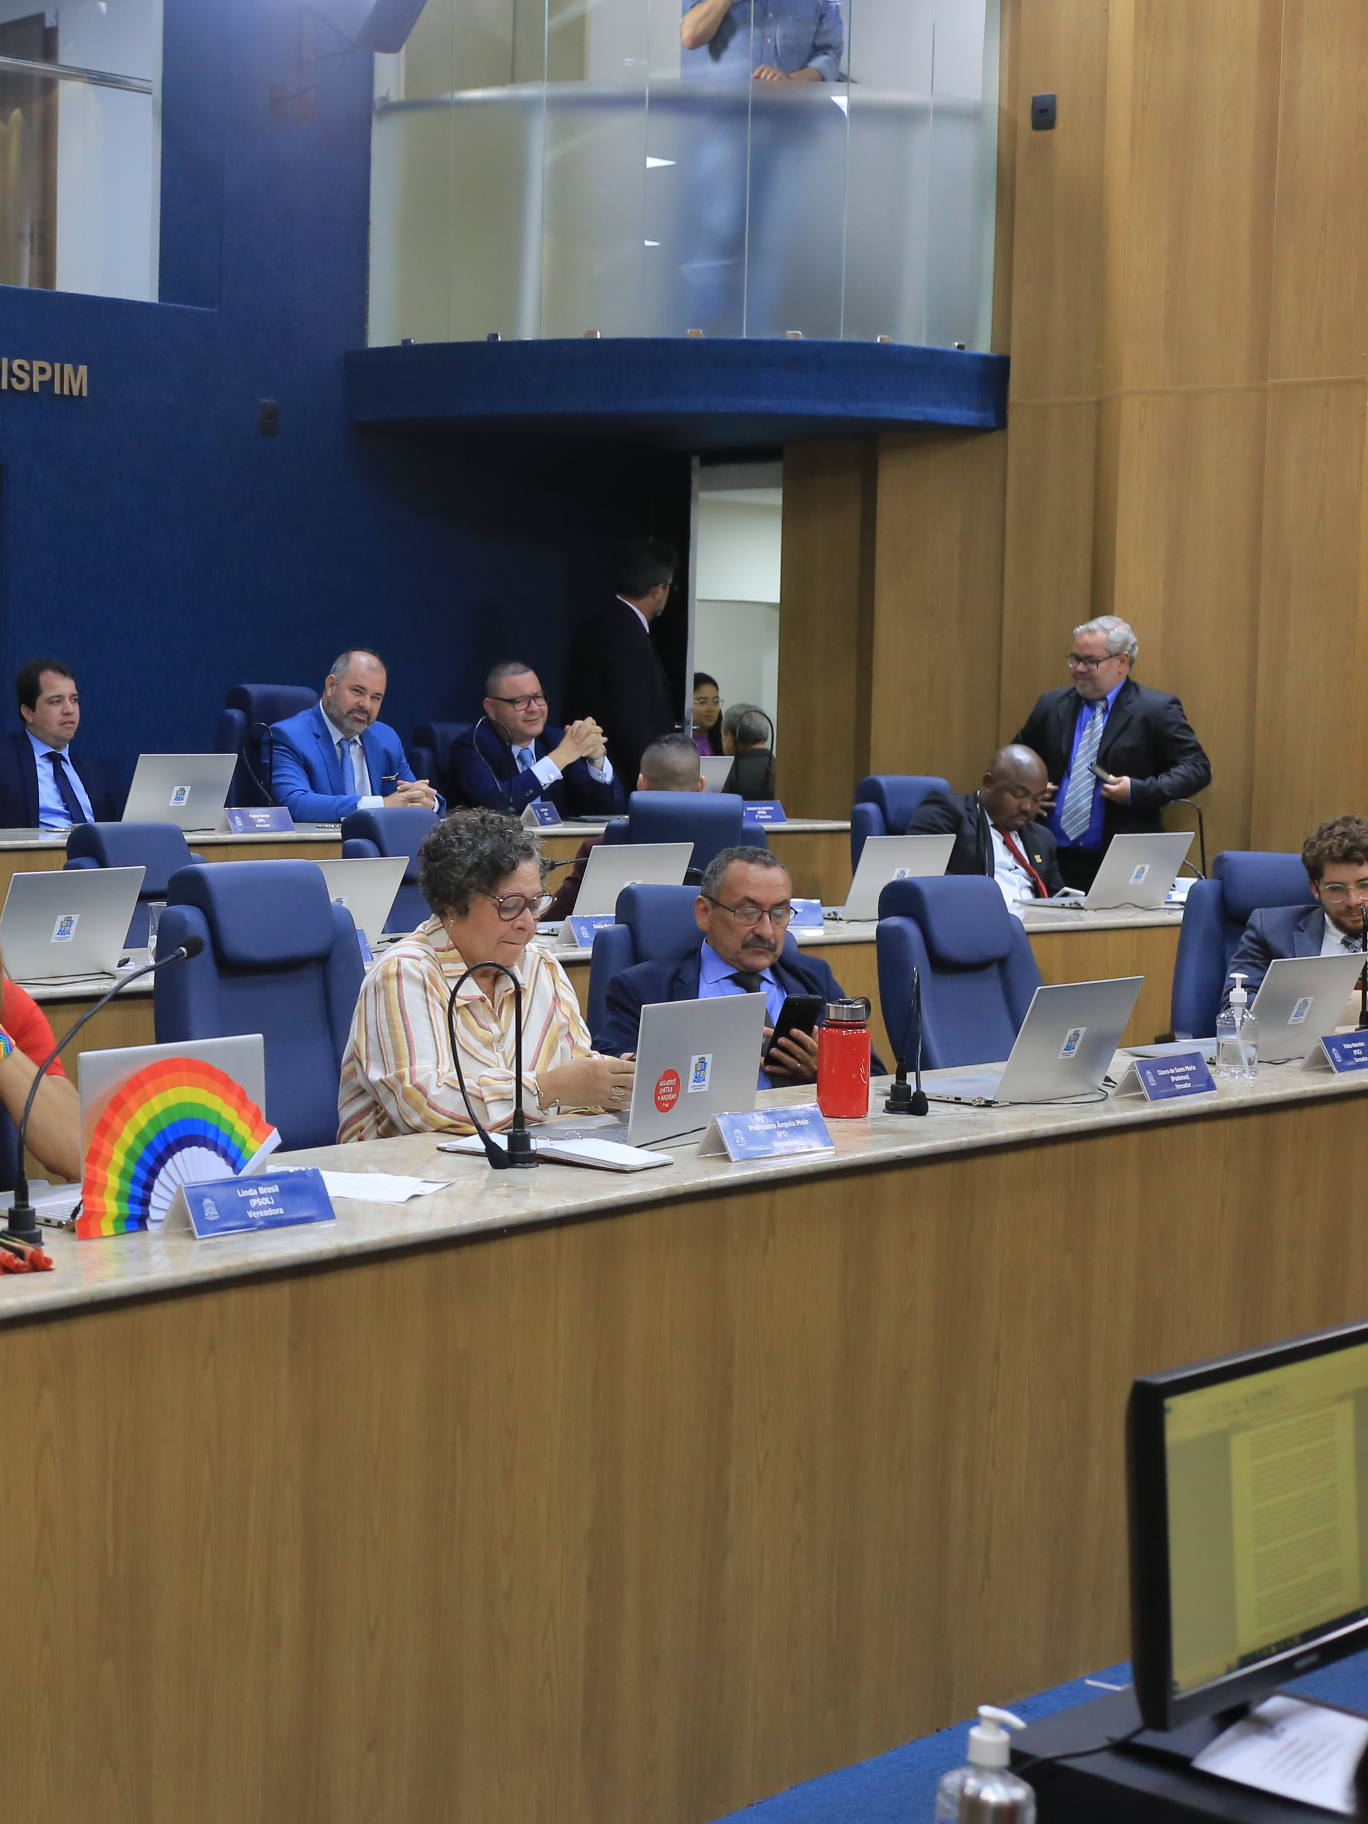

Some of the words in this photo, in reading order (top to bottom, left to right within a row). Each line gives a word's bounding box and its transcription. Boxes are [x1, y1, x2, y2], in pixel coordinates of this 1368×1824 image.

[748, 1122, 776, 1132] Professora
[237, 1186, 258, 1197] Linda
[258, 1185, 279, 1195] Brasil
[250, 1196, 274, 1208] (PSOL)
[247, 1208, 284, 1219] Vereadora
